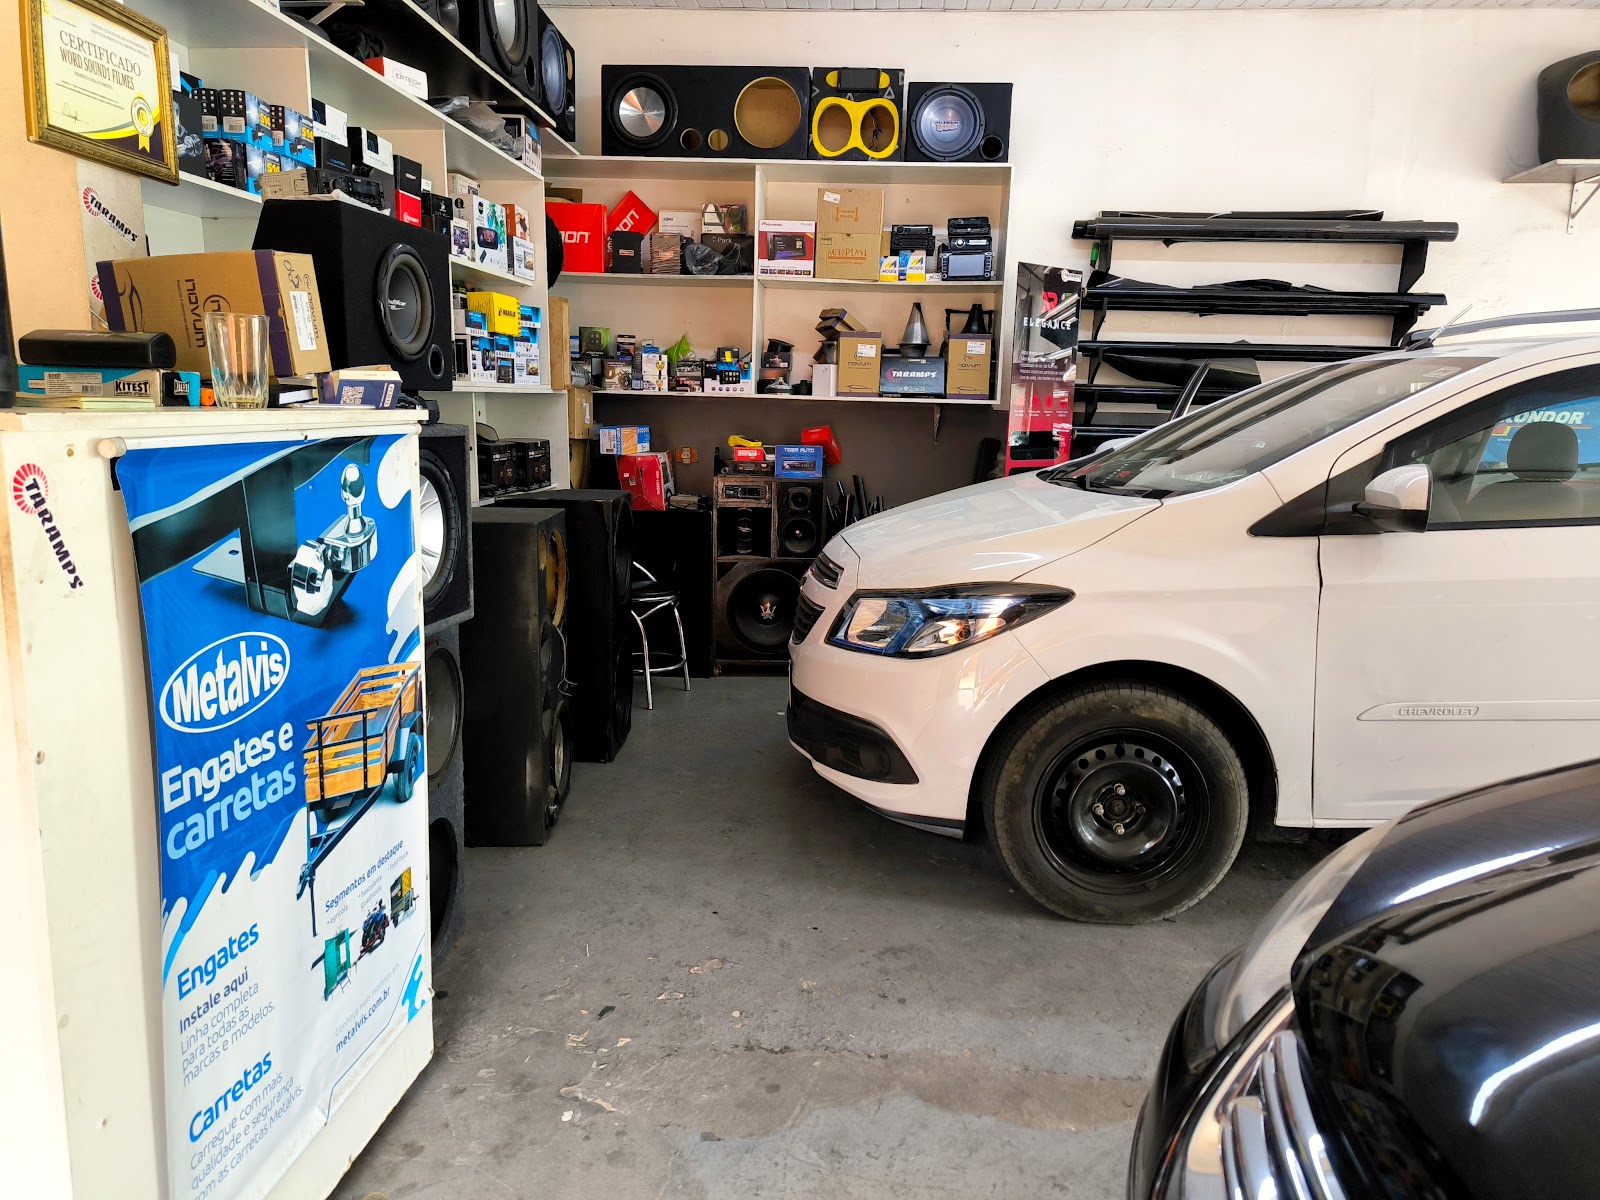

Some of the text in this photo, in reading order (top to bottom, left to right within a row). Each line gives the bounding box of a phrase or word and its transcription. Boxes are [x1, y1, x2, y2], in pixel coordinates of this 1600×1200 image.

[60, 30, 141, 77] CERTIFICADO
[60, 47, 83, 69] WORD
[84, 56, 111, 81] SOUND1
[112, 68, 135, 91] FILMES
[260, 112, 271, 128] S14
[301, 126, 314, 140] S14
[266, 162, 281, 173] S14
[90, 194, 138, 242] TARAMPS
[828, 248, 868, 257] AUTOPLAST
[1023, 316, 1072, 331] ELEGANCE
[115, 380, 150, 393] KITEST
[174, 381, 189, 392] KITEST
[892, 370, 937, 378] TARAMPS
[25, 477, 84, 589] TARAMPS
[172, 640, 285, 724] Metalvis
[1398, 706, 1478, 717] CHEVROLET
[161, 721, 294, 813] Engates e
[166, 761, 297, 860] carretas
[325, 840, 404, 912] Segmentos em destaque
[177, 922, 260, 1002] Engates
[180, 966, 249, 1034] Instale aqui
[180, 982, 260, 1056] Linha completa
[335, 986, 391, 1054] metalvis.com.br
[183, 1005, 250, 1074] para todas as
[183, 1000, 276, 1088] marcas e modelos.
[189, 1051, 273, 1143] Carretas
[190, 1071, 283, 1170] Carregue com mais
[192, 1076, 294, 1190] qualidade e segurança
[217, 1167, 230, 1183] as
[230, 1124, 269, 1169] carretas
[269, 1084, 304, 1129] Metalvis.
